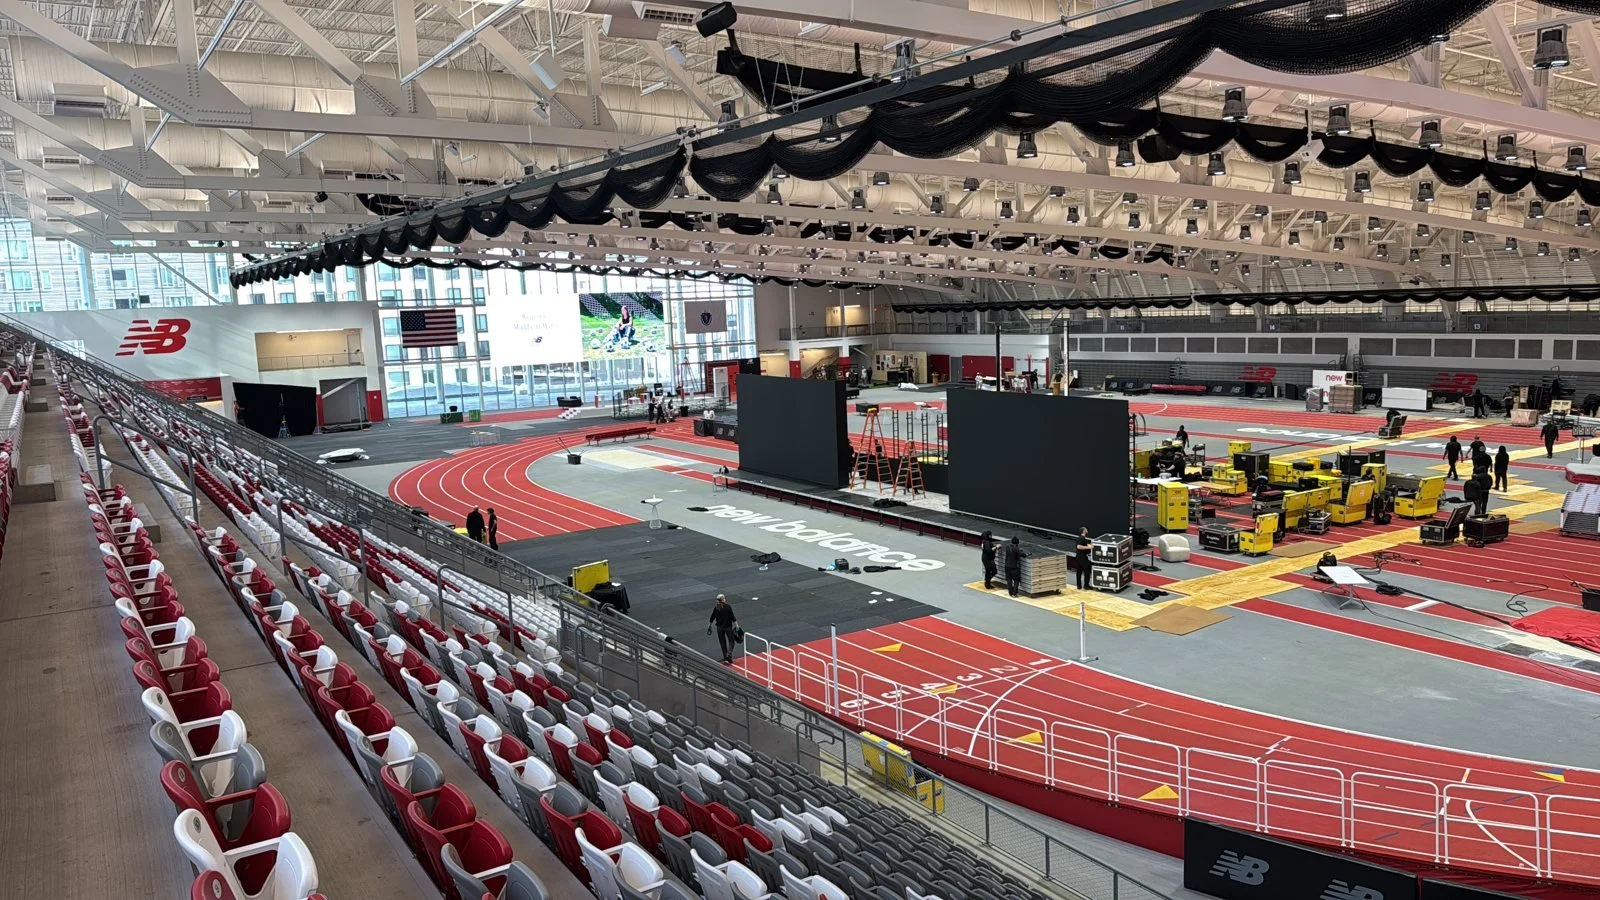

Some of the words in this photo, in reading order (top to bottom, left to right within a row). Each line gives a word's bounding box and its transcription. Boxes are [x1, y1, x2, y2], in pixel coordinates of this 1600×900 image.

[115, 318, 191, 356] NB
[1325, 374, 1343, 382] new
[706, 504, 783, 525] new
[758, 520, 946, 571] balance
[1028, 658, 1053, 666] 1
[989, 665, 1019, 674] 2
[956, 672, 984, 682] 3
[920, 681, 947, 690] 4
[880, 689, 911, 699] 5
[840, 698, 870, 709] 6
[1208, 850, 1270, 886] NB
